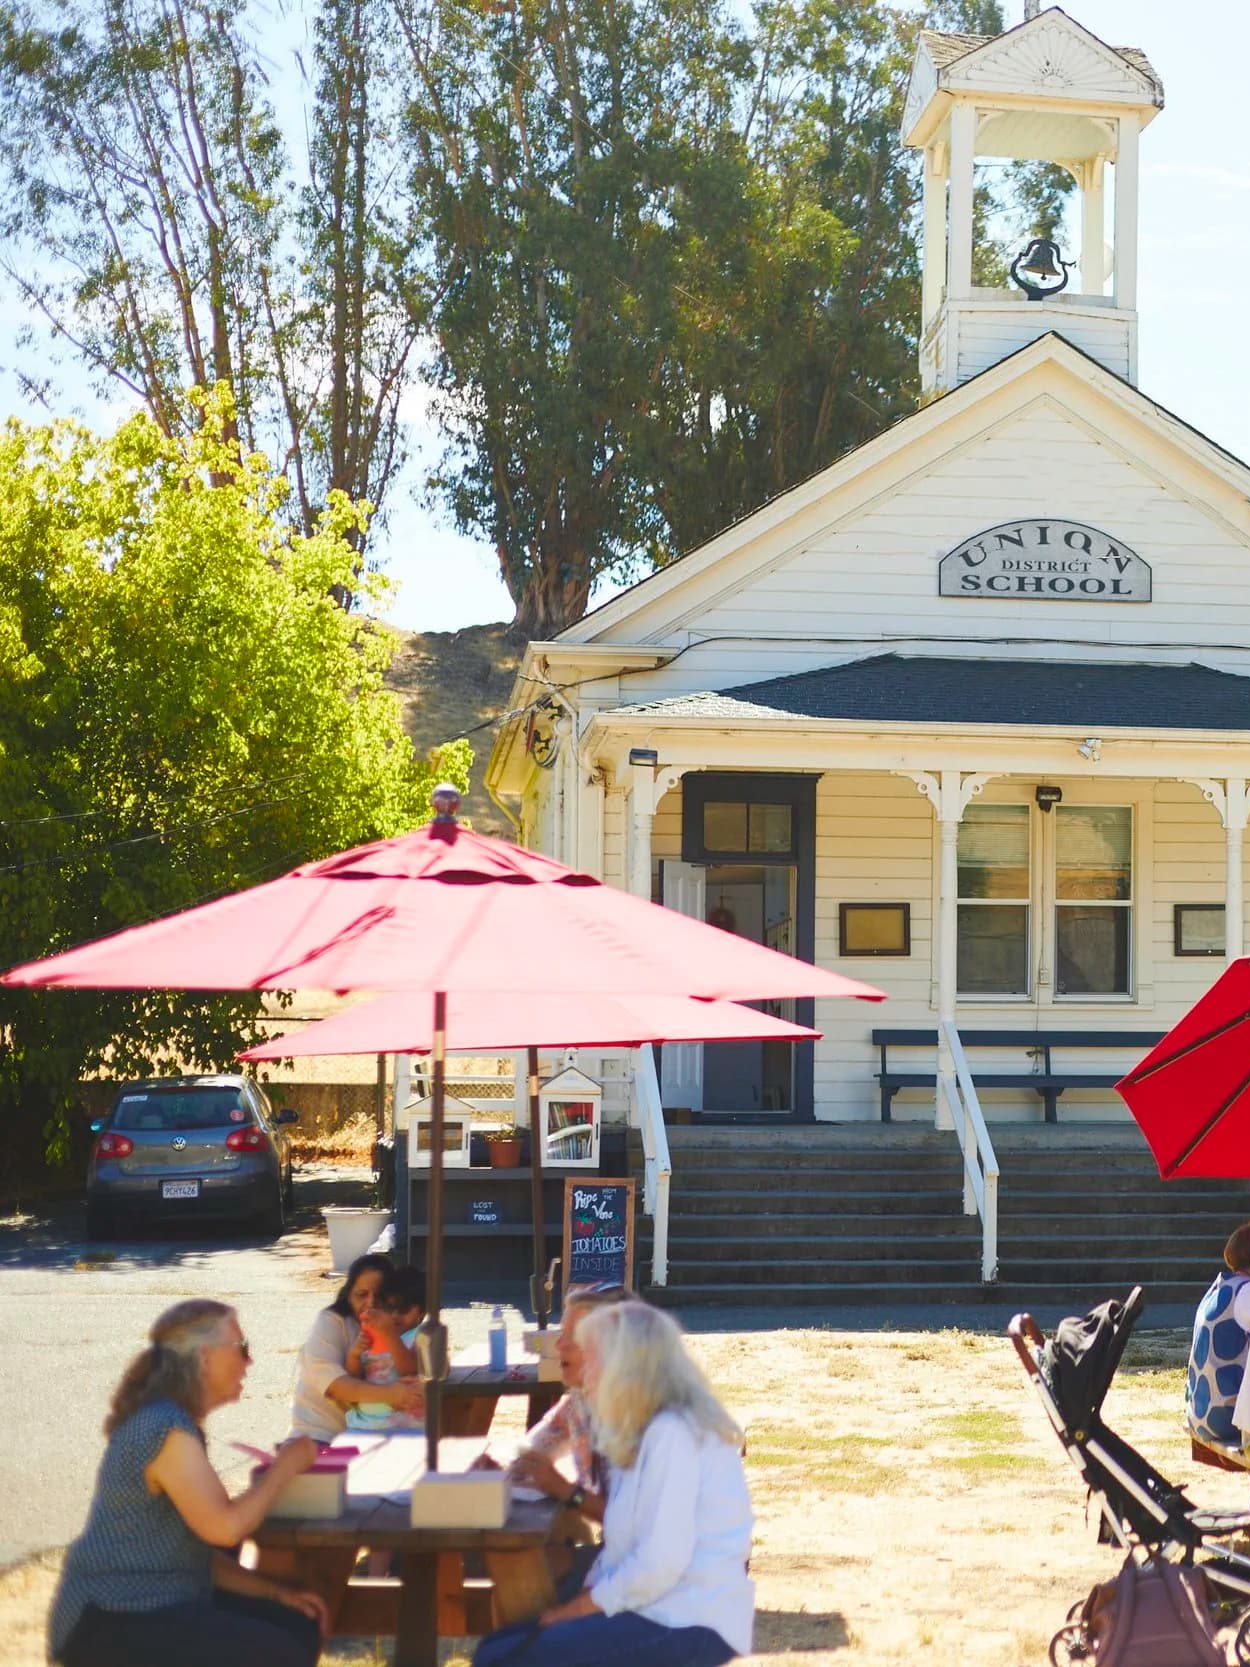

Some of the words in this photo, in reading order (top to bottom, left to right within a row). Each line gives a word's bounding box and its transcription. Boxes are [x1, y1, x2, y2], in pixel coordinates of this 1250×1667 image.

[1001, 559, 1092, 572] DISTRICT
[961, 574, 1132, 595] SCHOOL
[473, 1201, 493, 1209] LOST
[572, 1236, 627, 1251] TOMATOES
[574, 1257, 618, 1272] INSIDE
